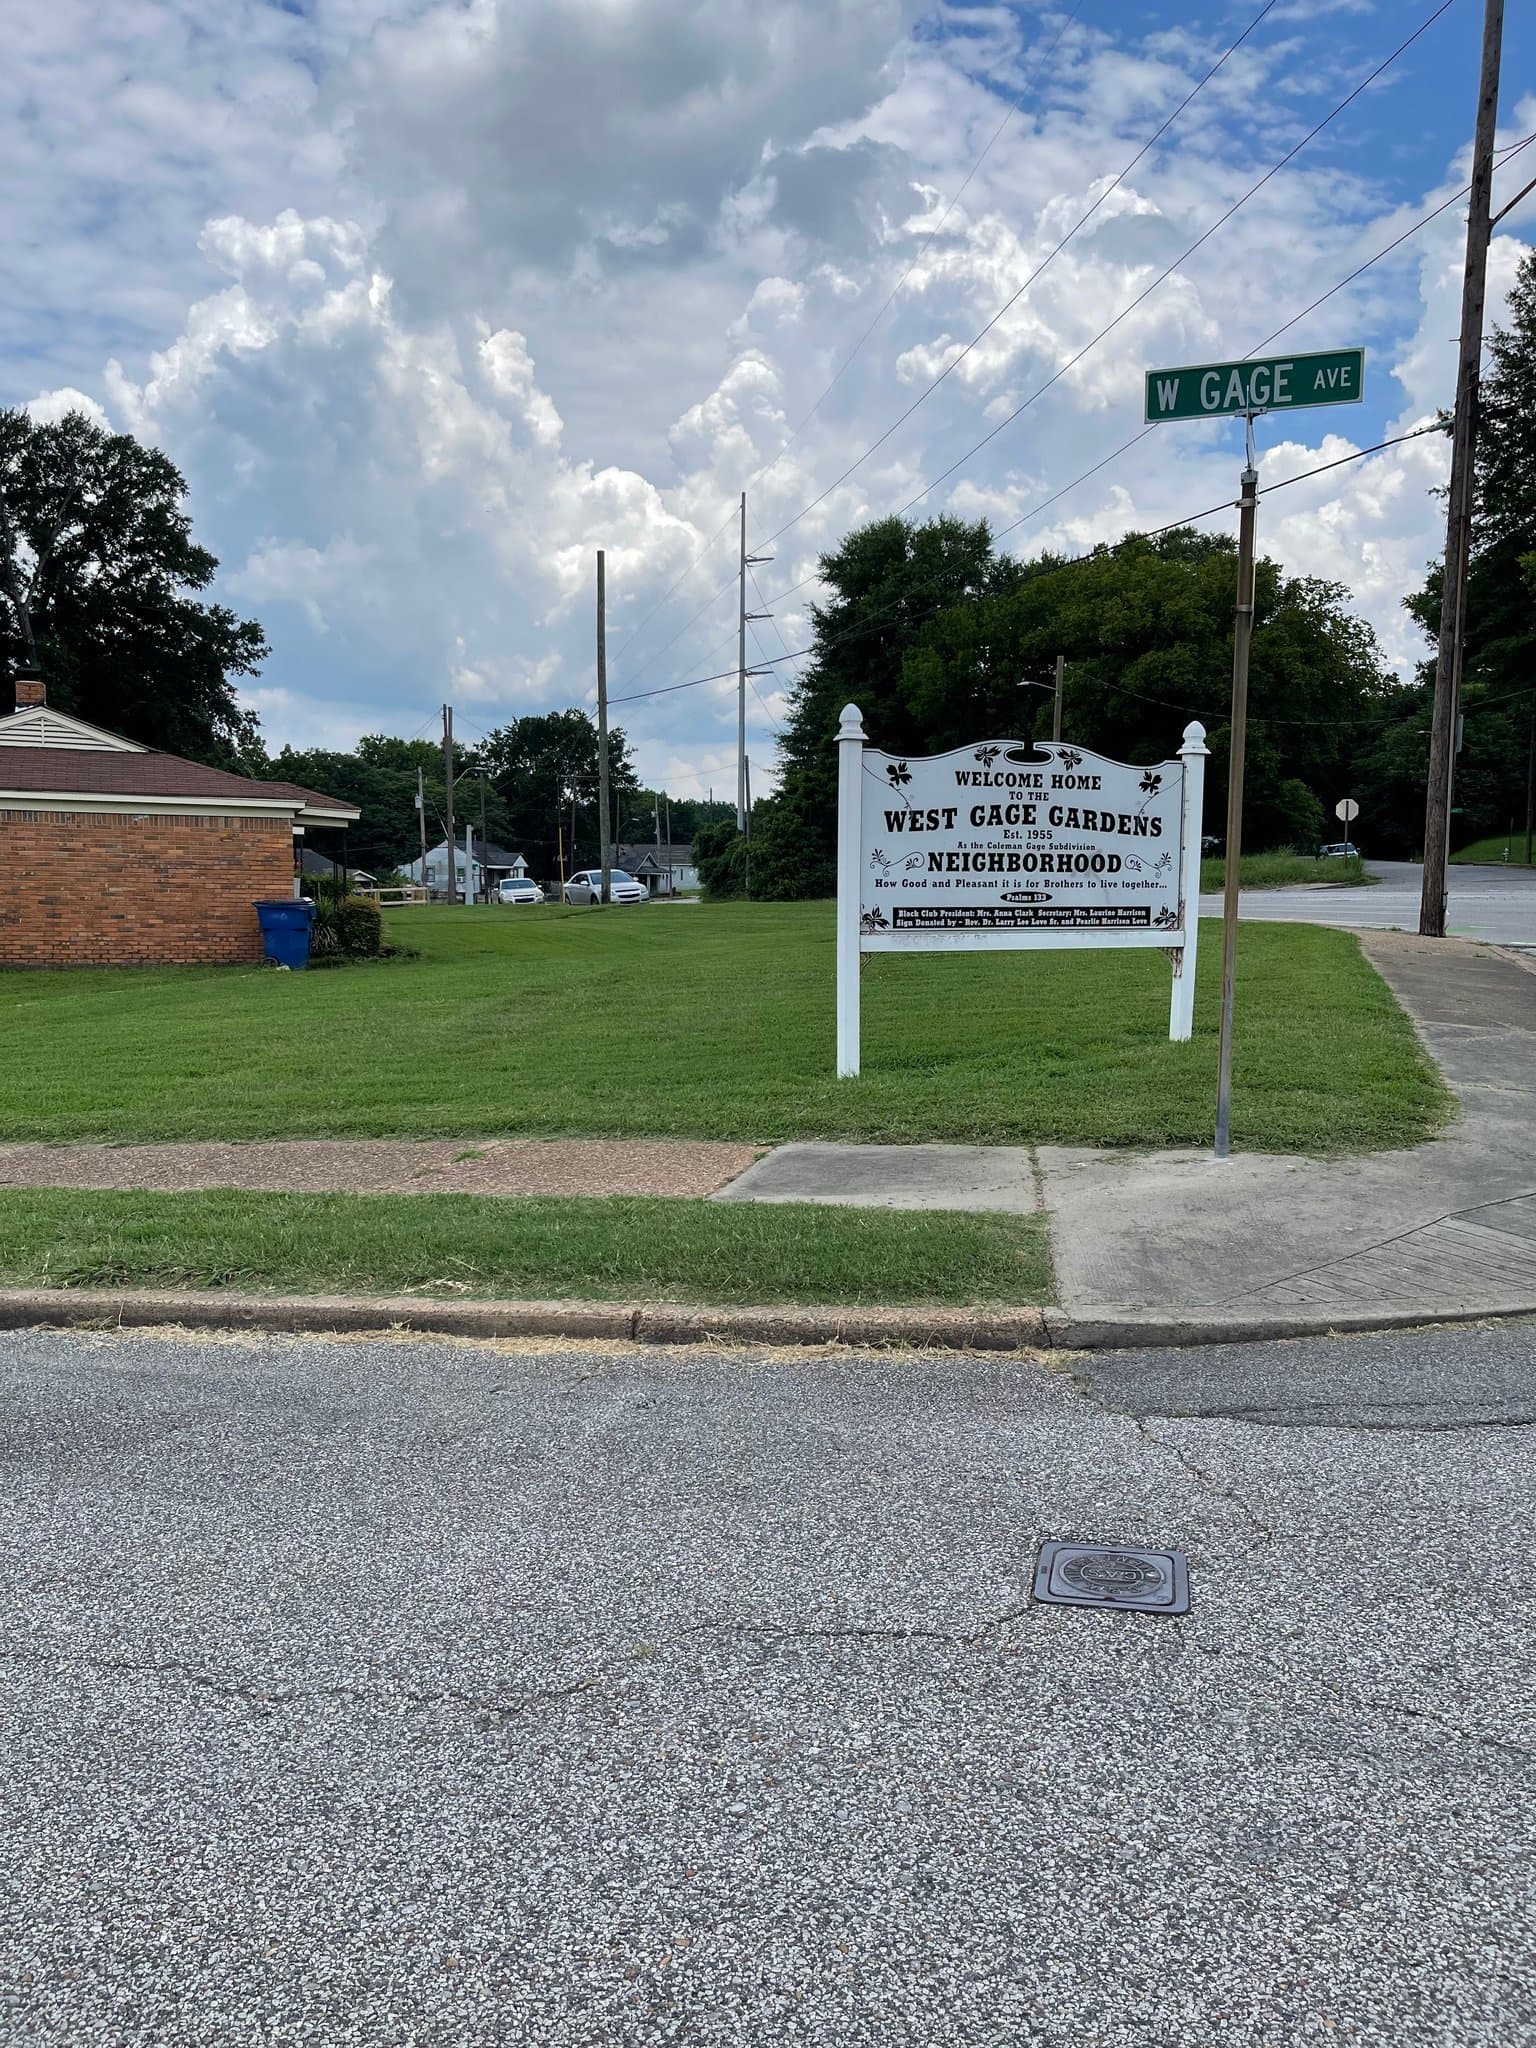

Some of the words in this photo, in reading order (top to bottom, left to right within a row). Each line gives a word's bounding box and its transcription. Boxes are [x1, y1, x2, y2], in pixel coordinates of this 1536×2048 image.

[1157, 378, 1179, 411] W
[1200, 364, 1294, 410] GAGE
[1313, 366, 1351, 390] AVE
[955, 771, 1043, 788] WELCOME
[1051, 774, 1102, 790] HOME
[1008, 791, 1023, 800] TO
[1028, 792, 1049, 801] THE
[884, 807, 957, 832] WEST
[970, 803, 1036, 827] GAGE
[1048, 805, 1162, 837] GARDENS
[1003, 829, 1023, 839] Est.
[1027, 830, 1053, 840] 1955
[957, 841, 967, 849] As
[971, 841, 983, 849] the
[987, 842, 1022, 850] Coleman
[1026, 842, 1045, 851] Gage
[1049, 842, 1096, 851] Subdivision
[927, 852, 1122, 873] NEIGHBORHOOD
[875, 879, 897, 888] How
[902, 879, 927, 888] Good
[932, 879, 951, 888] and
[955, 879, 998, 888] Pleasant
[1002, 879, 1009, 888] it
[1013, 879, 1021, 888] is
[1026, 879, 1040, 888] for
[1044, 879, 1083, 888] Brothers
[1087, 880, 1096, 888] to
[1100, 879, 1118, 888] live
[1122, 880, 1167, 890] together...
[1006, 893, 1031, 901] Psalms
[1034, 893, 1047, 901] 133
[898, 909, 919, 917] Block
[921, 909, 938, 917] Club
[940, 909, 975, 917] President:
[977, 909, 992, 917] Mrs.
[993, 909, 1012, 917] Anna
[1014, 909, 1034, 917] Clark
[1073, 909, 1088, 917] Mrs.
[1117, 909, 1146, 917] Harrison
[896, 918, 913, 927] Sign
[915, 919, 945, 927] Donated
[947, 918, 958, 928] by
[982, 918, 993, 926] Dr.
[995, 918, 1015, 927] Larry
[1031, 918, 1047, 926] Love
[1061, 918, 1074, 926] and
[1101, 917, 1130, 926] Harrison
[1132, 917, 1148, 926] Love
